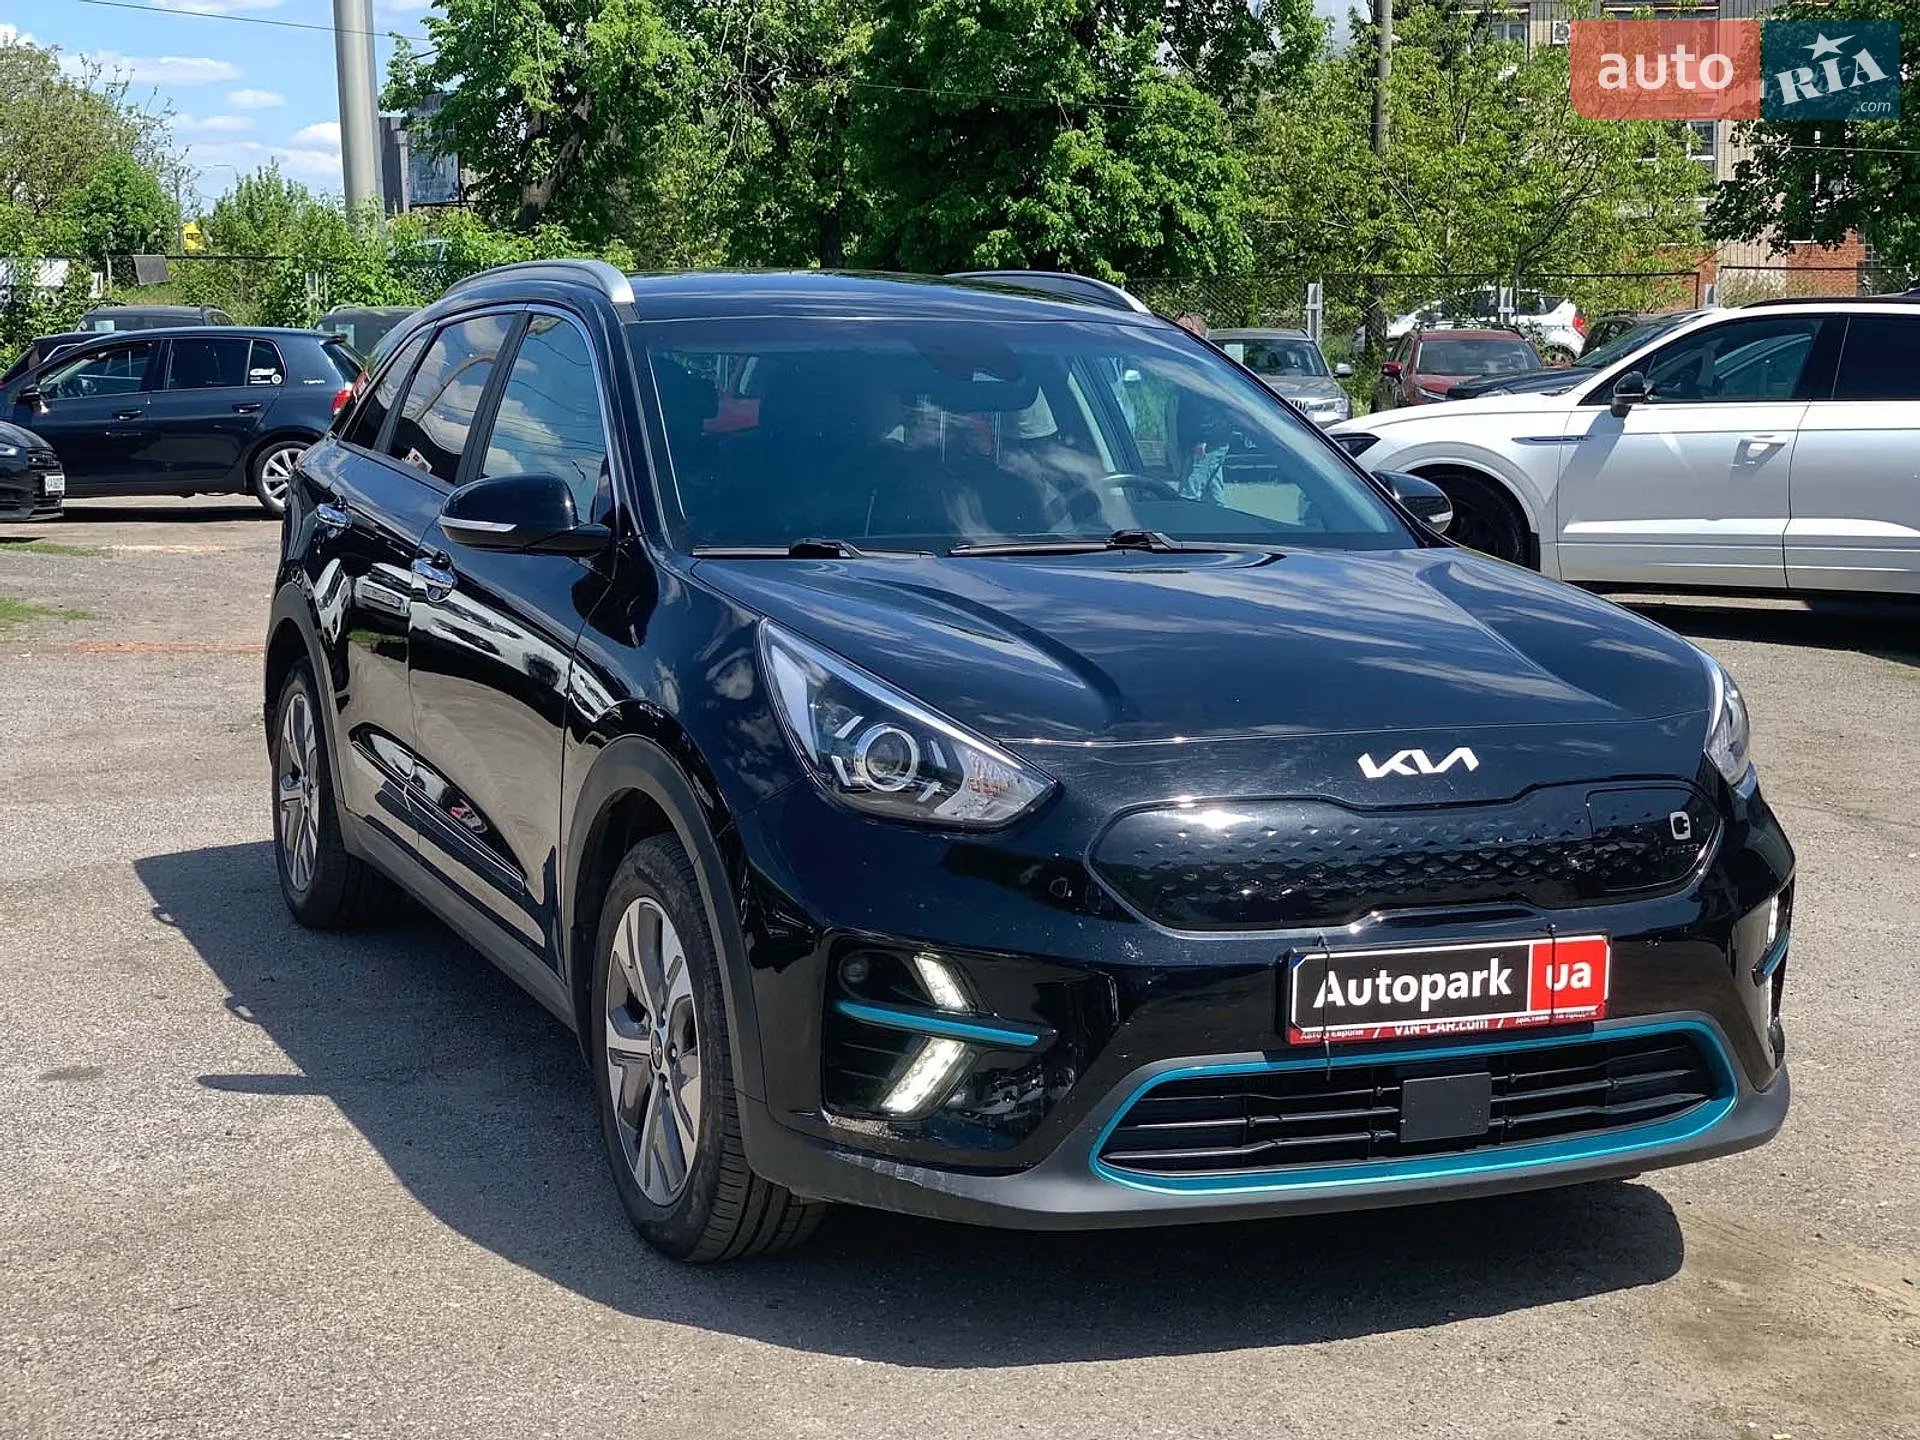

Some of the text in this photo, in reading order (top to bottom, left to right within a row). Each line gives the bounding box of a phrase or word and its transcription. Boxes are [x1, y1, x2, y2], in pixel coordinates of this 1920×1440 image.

[1357, 747, 1480, 779] KIA
[1313, 957, 1592, 1012] Autopark ua
